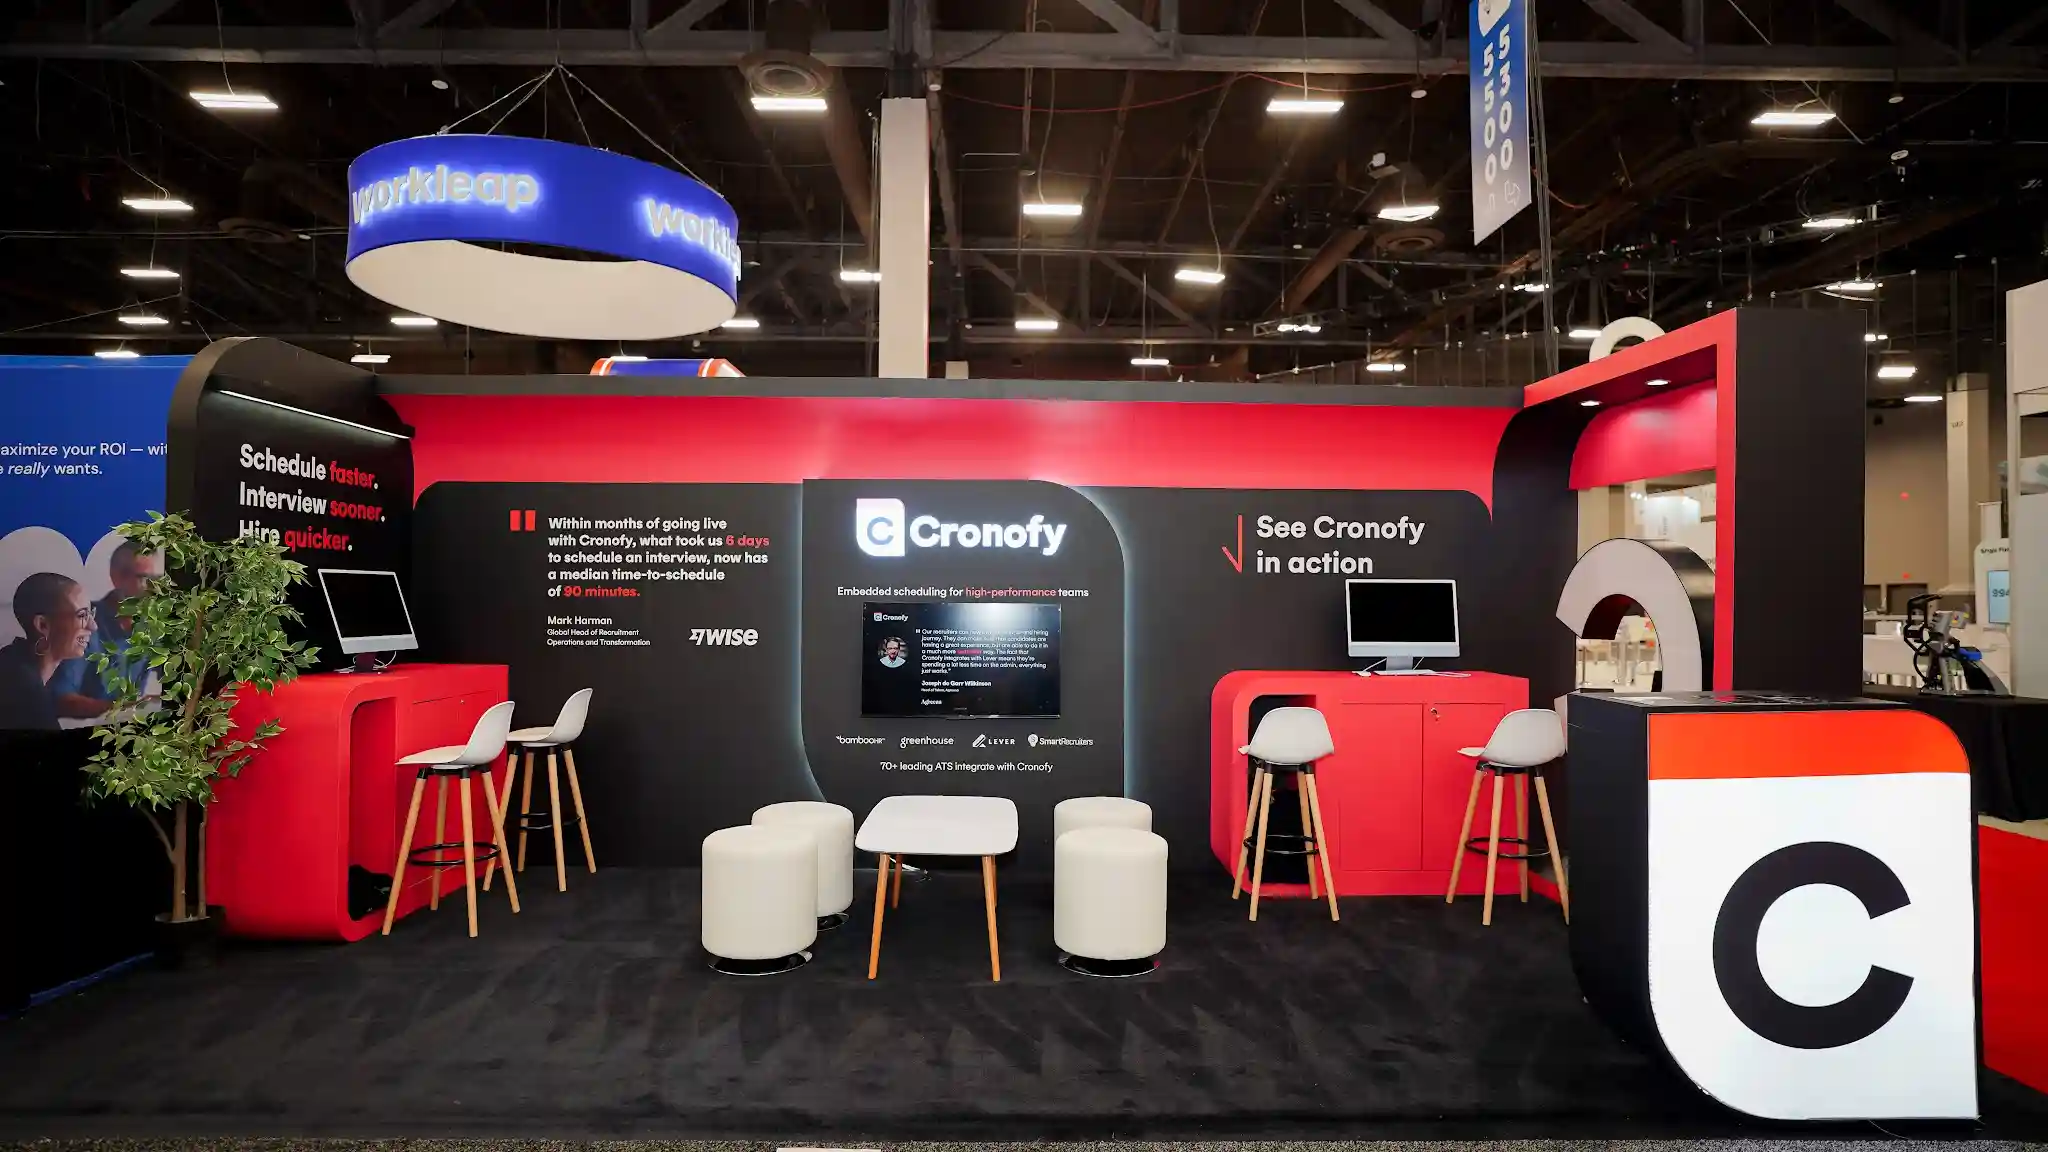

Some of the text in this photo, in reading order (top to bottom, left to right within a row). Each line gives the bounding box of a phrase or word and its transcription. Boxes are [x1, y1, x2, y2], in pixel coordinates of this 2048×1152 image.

[1499, 24, 1513, 170] 5300
[1483, 42, 1497, 185] 5500
[352, 164, 540, 225] workleap
[62, 445, 97, 458] your
[100, 443, 126, 456] ROI
[8, 462, 51, 478] really
[54, 463, 103, 475] wants.
[240, 443, 379, 490] Schedule faster.
[239, 481, 386, 523] Interview sooner.
[548, 517, 728, 533] Within months of going live
[1256, 514, 1426, 546] See Cronofy
[239, 519, 353, 552] Hire quicker.
[548, 534, 770, 549] with Cronofy, what took us 6 days
[909, 514, 1068, 556] Cronofy
[548, 551, 769, 566] to schedule an interview, now has
[1256, 550, 1374, 574] in action
[547, 567, 726, 580] a median time-to-schedule
[547, 585, 641, 597] of 90 minutes.
[837, 586, 1089, 600] Embedded scheduling for high-performance teams
[547, 615, 613, 625] Mark Harman
[883, 614, 909, 622] Cronofy
[547, 628, 640, 636] Global Head of Recruitment
[546, 638, 651, 647] Operations and Transformation
[900, 736, 955, 749] greenhouse
[1039, 736, 1094, 746] SmartRecruiters
[880, 761, 1054, 773] 70+ leading ATS integrate with Cronofy
[1712, 840, 1915, 1050] C
